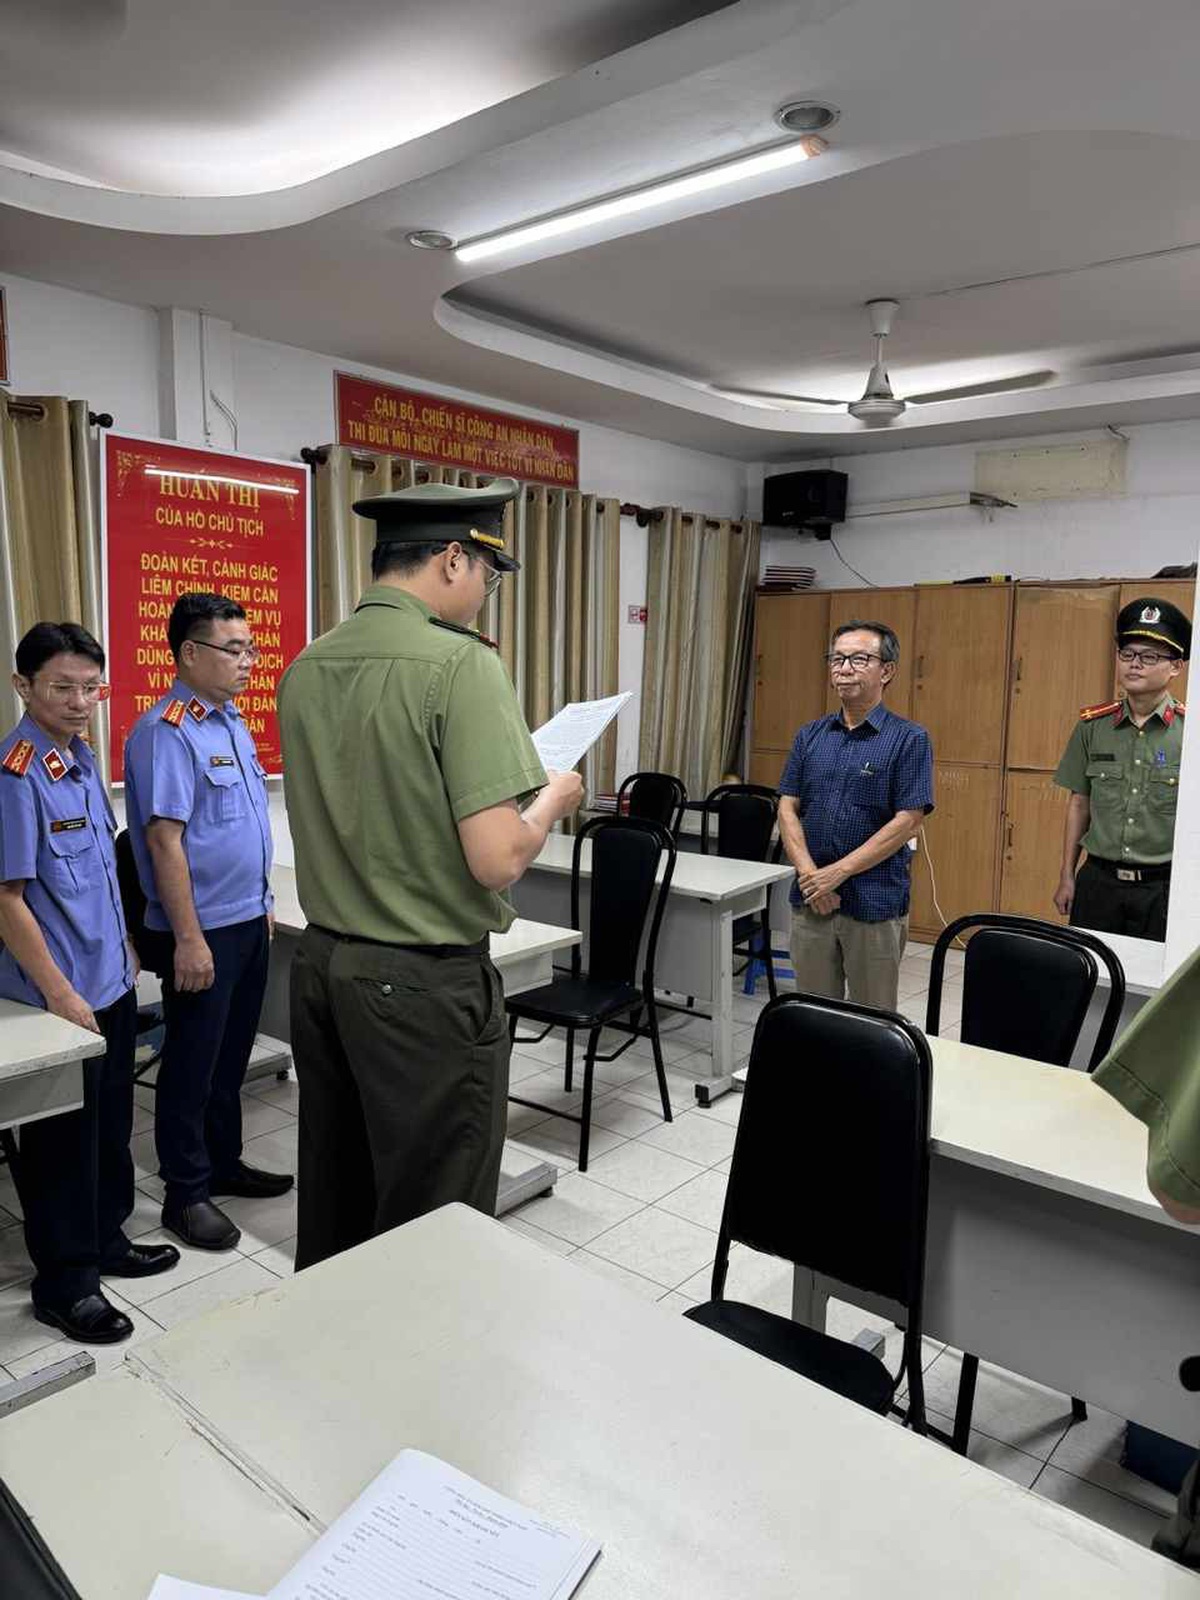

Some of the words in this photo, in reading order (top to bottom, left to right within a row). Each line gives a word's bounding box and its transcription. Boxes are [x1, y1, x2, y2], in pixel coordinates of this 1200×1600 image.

[348, 420, 366, 441] THI
[422, 405, 452, 430] CHIẾN
[467, 415, 494, 440] CÔNG
[225, 482, 260, 513] THỊ
[156, 504, 183, 527] CỦA
[208, 512, 234, 533] CHỦ
[237, 517, 264, 538] TỊCH
[141, 551, 178, 573] ĐOÀN
[212, 558, 246, 579] CẢNH
[249, 562, 278, 582] GIÁC
[141, 574, 172, 595] LIÊM
[265, 611, 282, 631] VỤ
[137, 644, 175, 665] DŨNG
[249, 670, 275, 690] HÂN
[253, 693, 278, 712] ĐẢN
